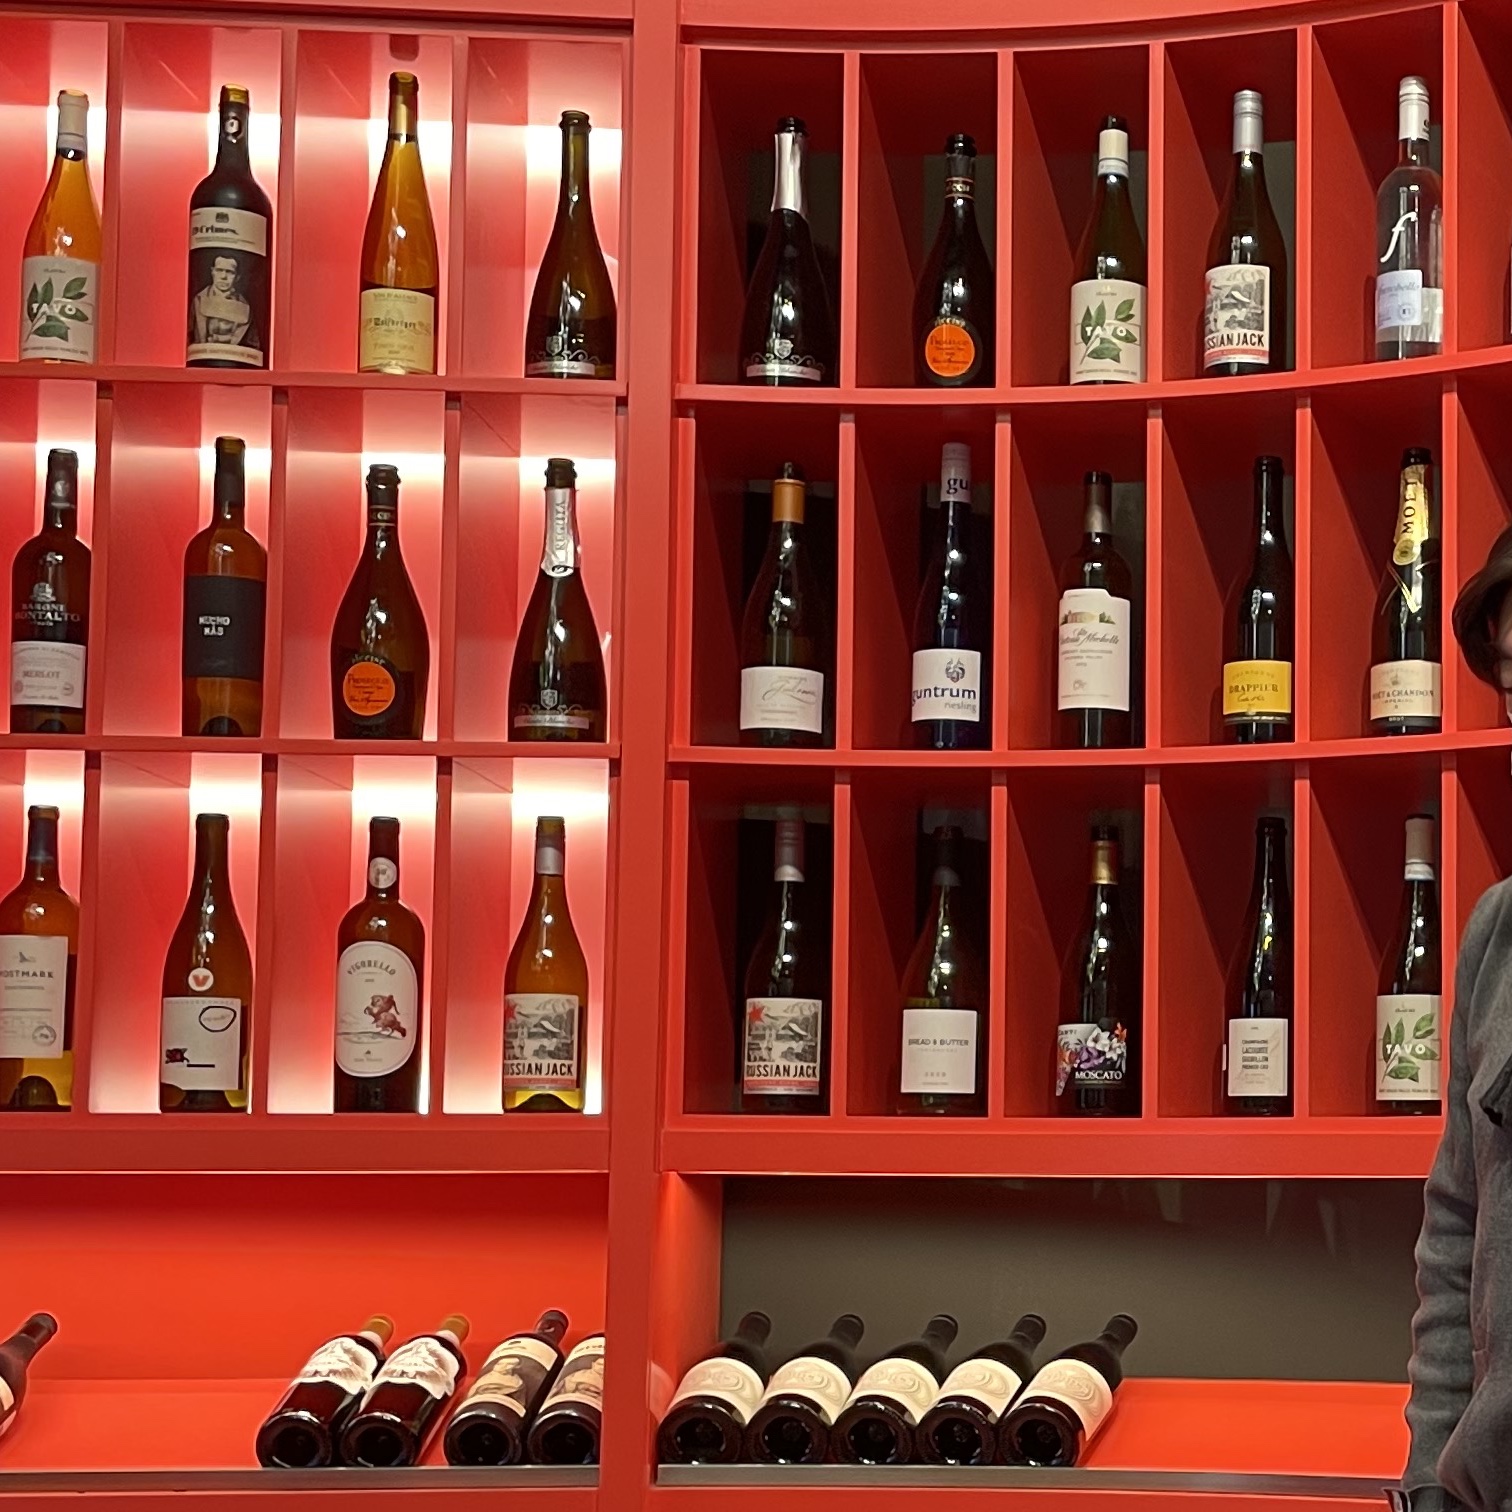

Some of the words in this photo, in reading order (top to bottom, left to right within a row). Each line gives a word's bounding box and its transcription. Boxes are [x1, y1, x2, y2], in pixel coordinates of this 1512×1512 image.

[1235, 332, 1265, 348] JACK
[199, 615, 231, 626] MUCHO
[1229, 683, 1279, 694] DRAPPIER
[912, 687, 978, 708] guntrum
[1385, 1042, 1427, 1055] TAVO
[544, 1063, 574, 1077] JACK
[746, 1064, 791, 1078] RUSSIAN
[792, 1064, 818, 1079] JACK
[1075, 1070, 1123, 1082] MOSCATO
